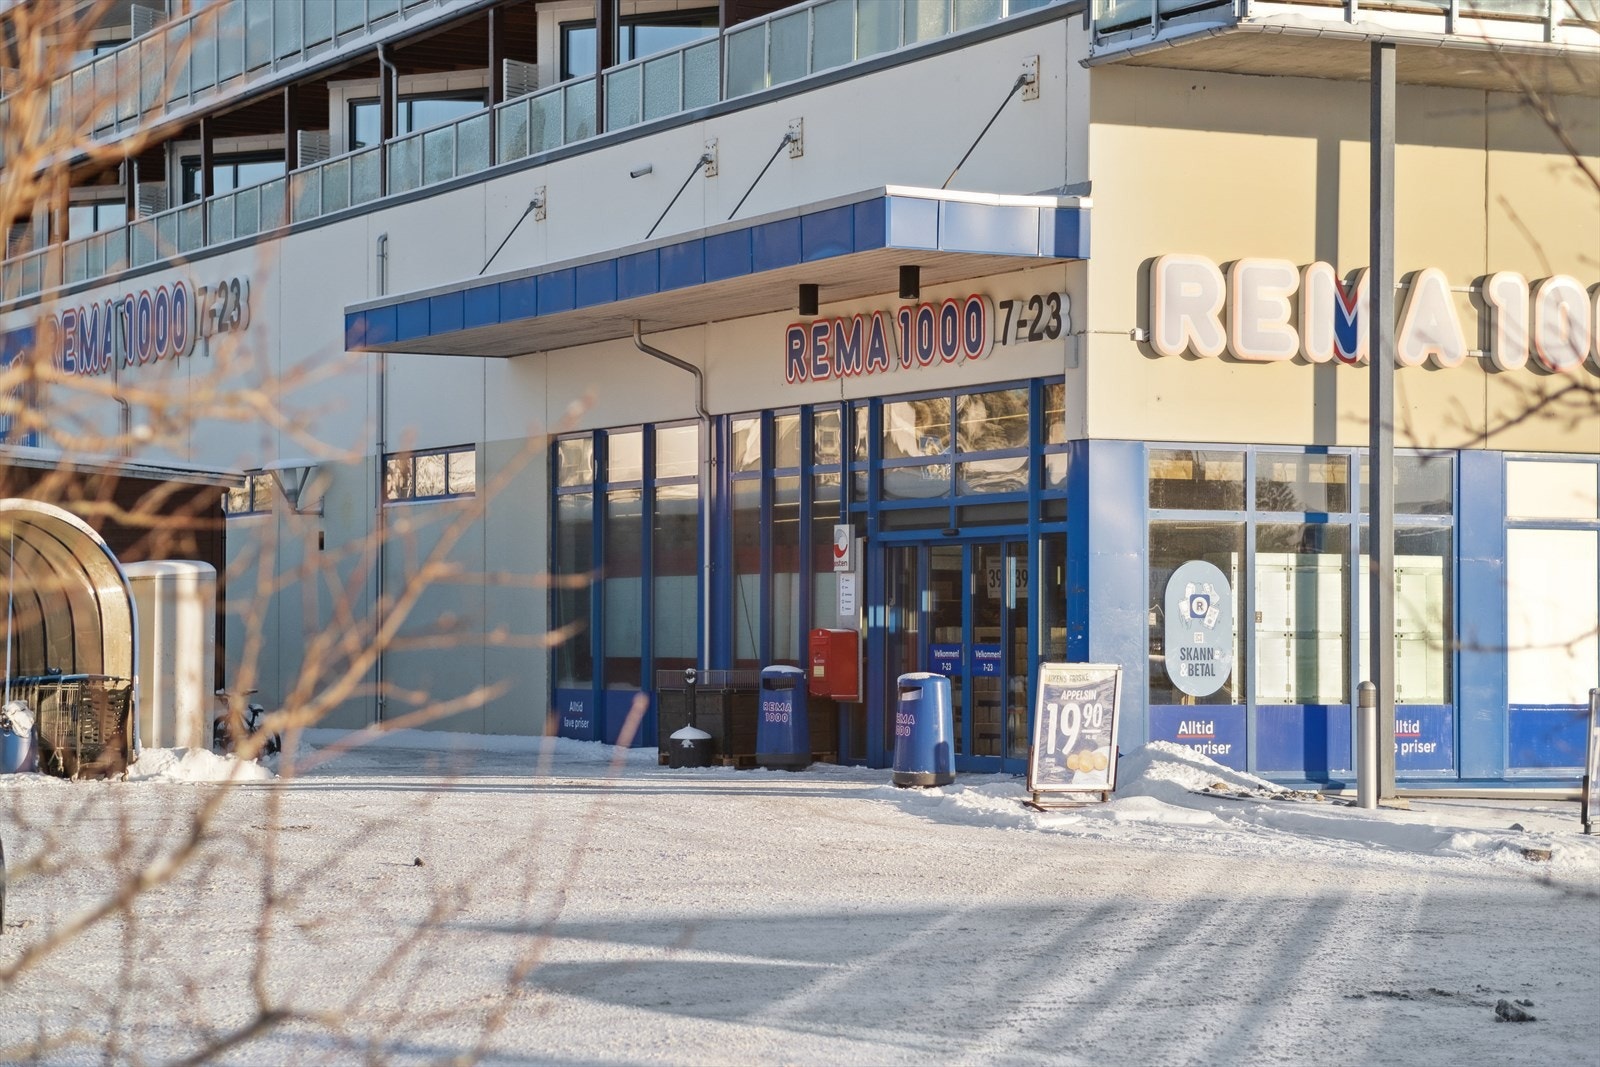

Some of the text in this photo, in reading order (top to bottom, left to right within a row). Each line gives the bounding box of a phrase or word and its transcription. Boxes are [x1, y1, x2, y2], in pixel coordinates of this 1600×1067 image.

[1152, 253, 1600, 373] REMA 10
[124, 281, 188, 365] 1000
[198, 277, 245, 337] 7-23
[785, 291, 1063, 385] REMA 1000 7-23
[1180, 647, 1214, 661] SKANN
[941, 663, 952, 671] 7-23
[983, 663, 993, 671] 7-23
[1061, 690, 1097, 700] APPELSIN
[763, 702, 792, 712] REMA
[765, 713, 788, 723] 1000
[1047, 703, 1103, 755] 19 90
[1178, 720, 1214, 735] Alltid
[1394, 720, 1419, 734] lltid
[1194, 741, 1231, 755] priser
[1401, 739, 1437, 756] priser
